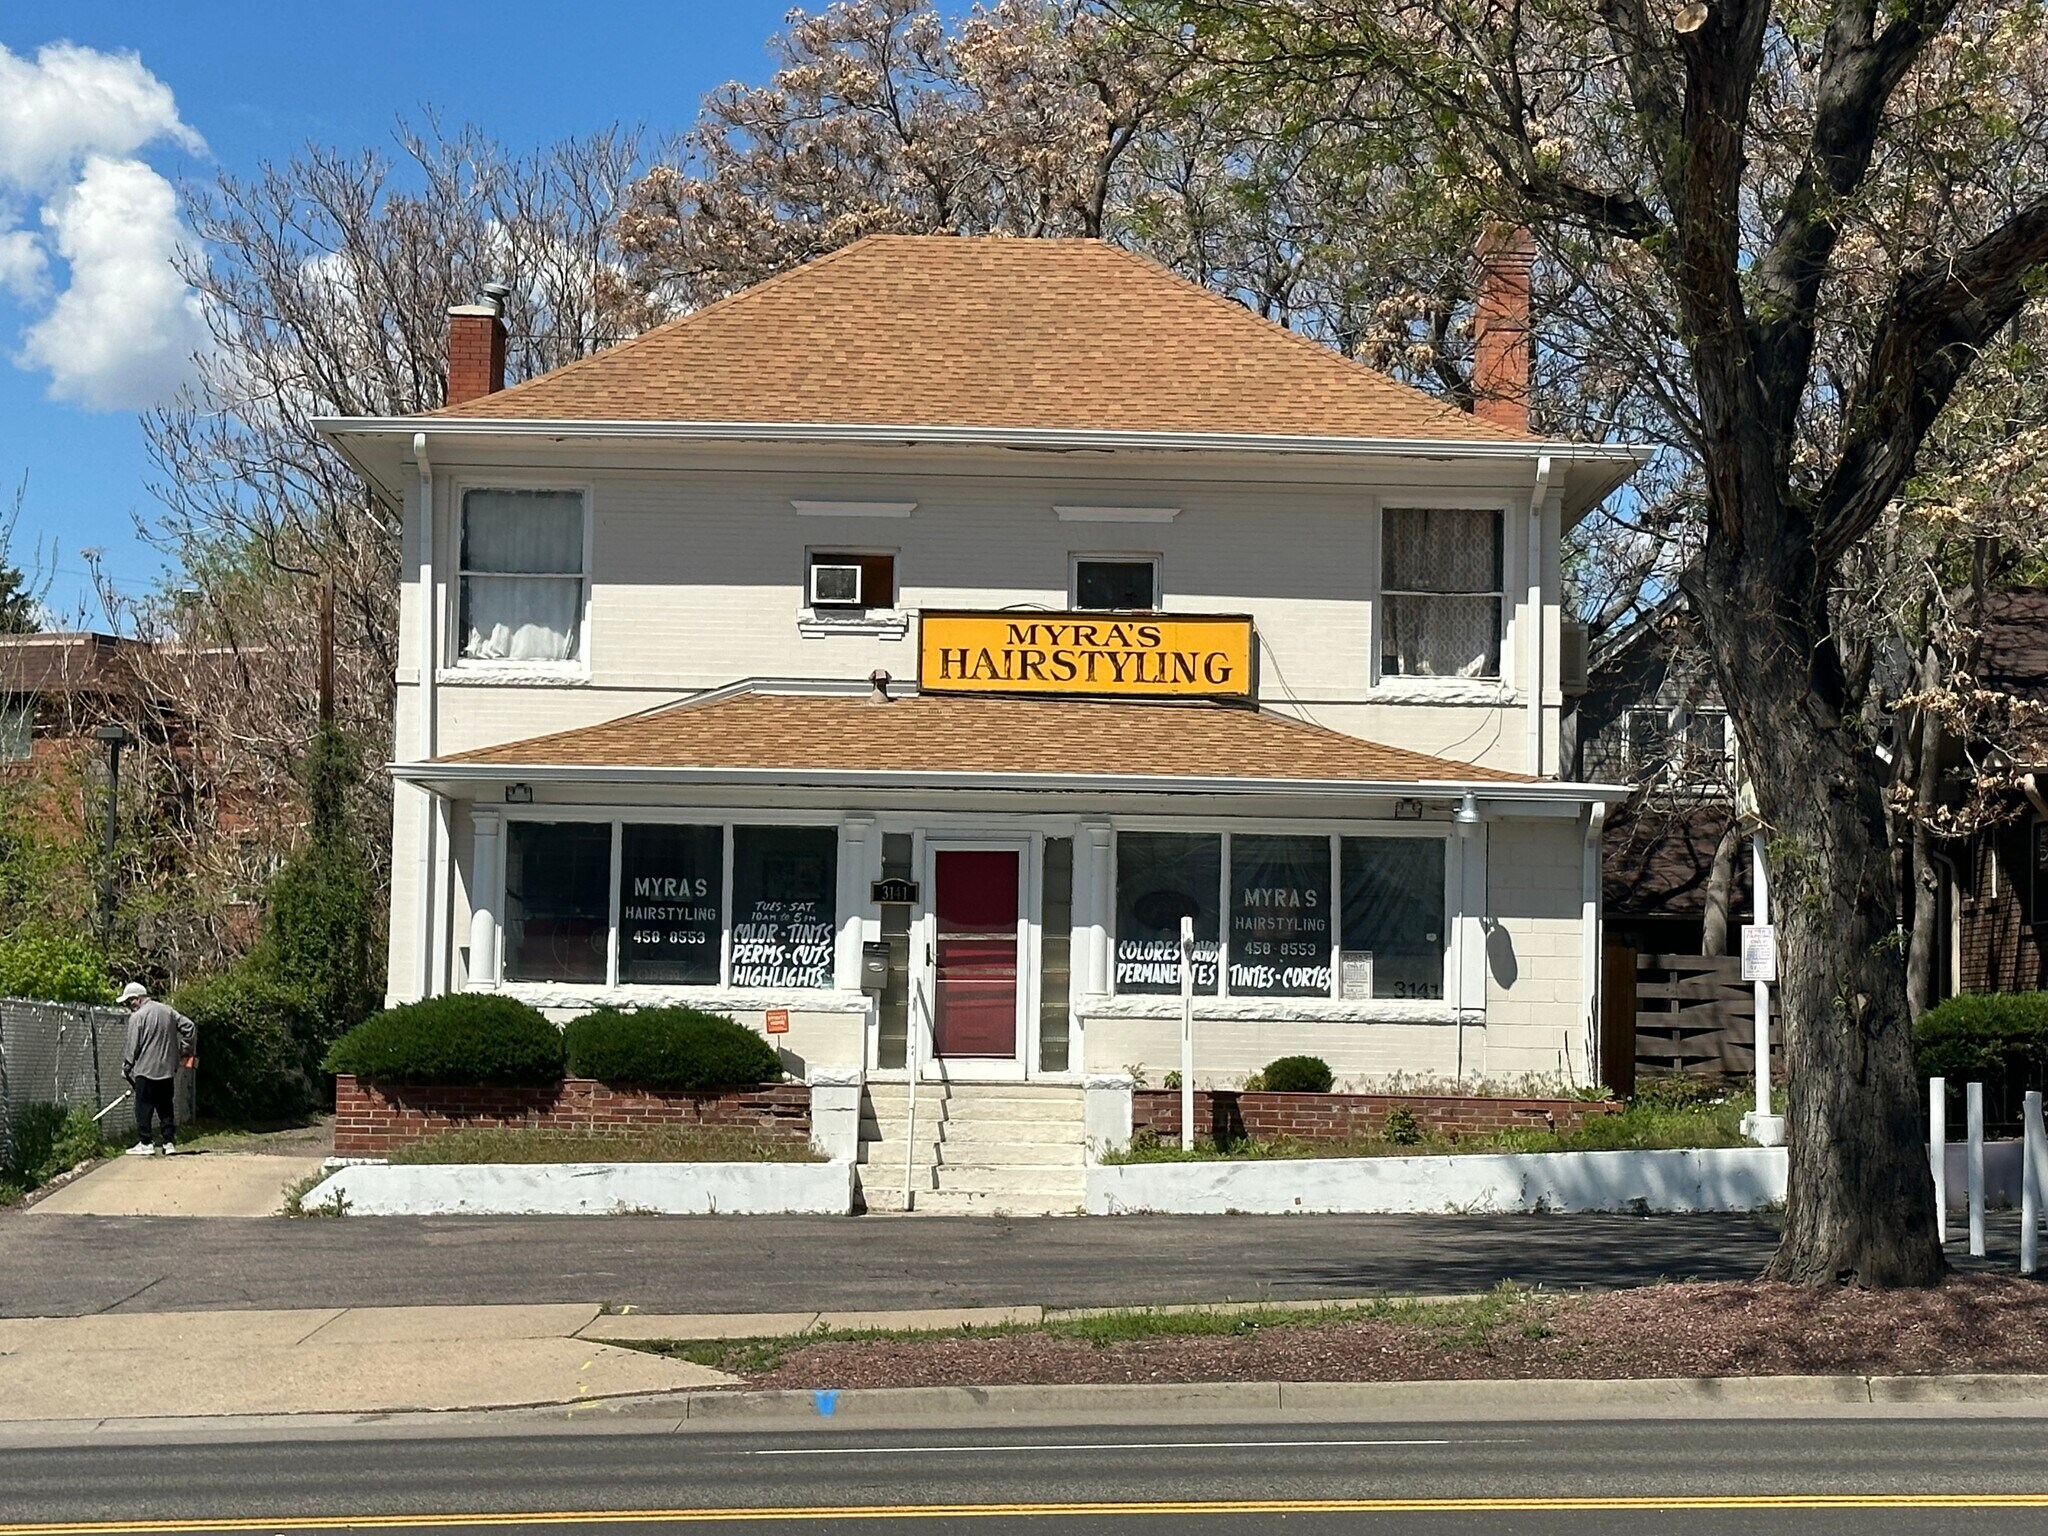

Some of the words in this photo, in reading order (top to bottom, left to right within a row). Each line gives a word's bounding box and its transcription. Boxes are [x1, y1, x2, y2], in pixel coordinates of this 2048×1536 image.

[1006, 623, 1162, 648] MYRA'S
[939, 648, 1232, 684] HAIRSTYLING
[881, 885, 907, 900] 3141
[625, 906, 717, 921] HAIRSTYLING
[1235, 916, 1326, 932] HAIRSTYLING
[732, 965, 825, 988] HIGHLIGHTS
